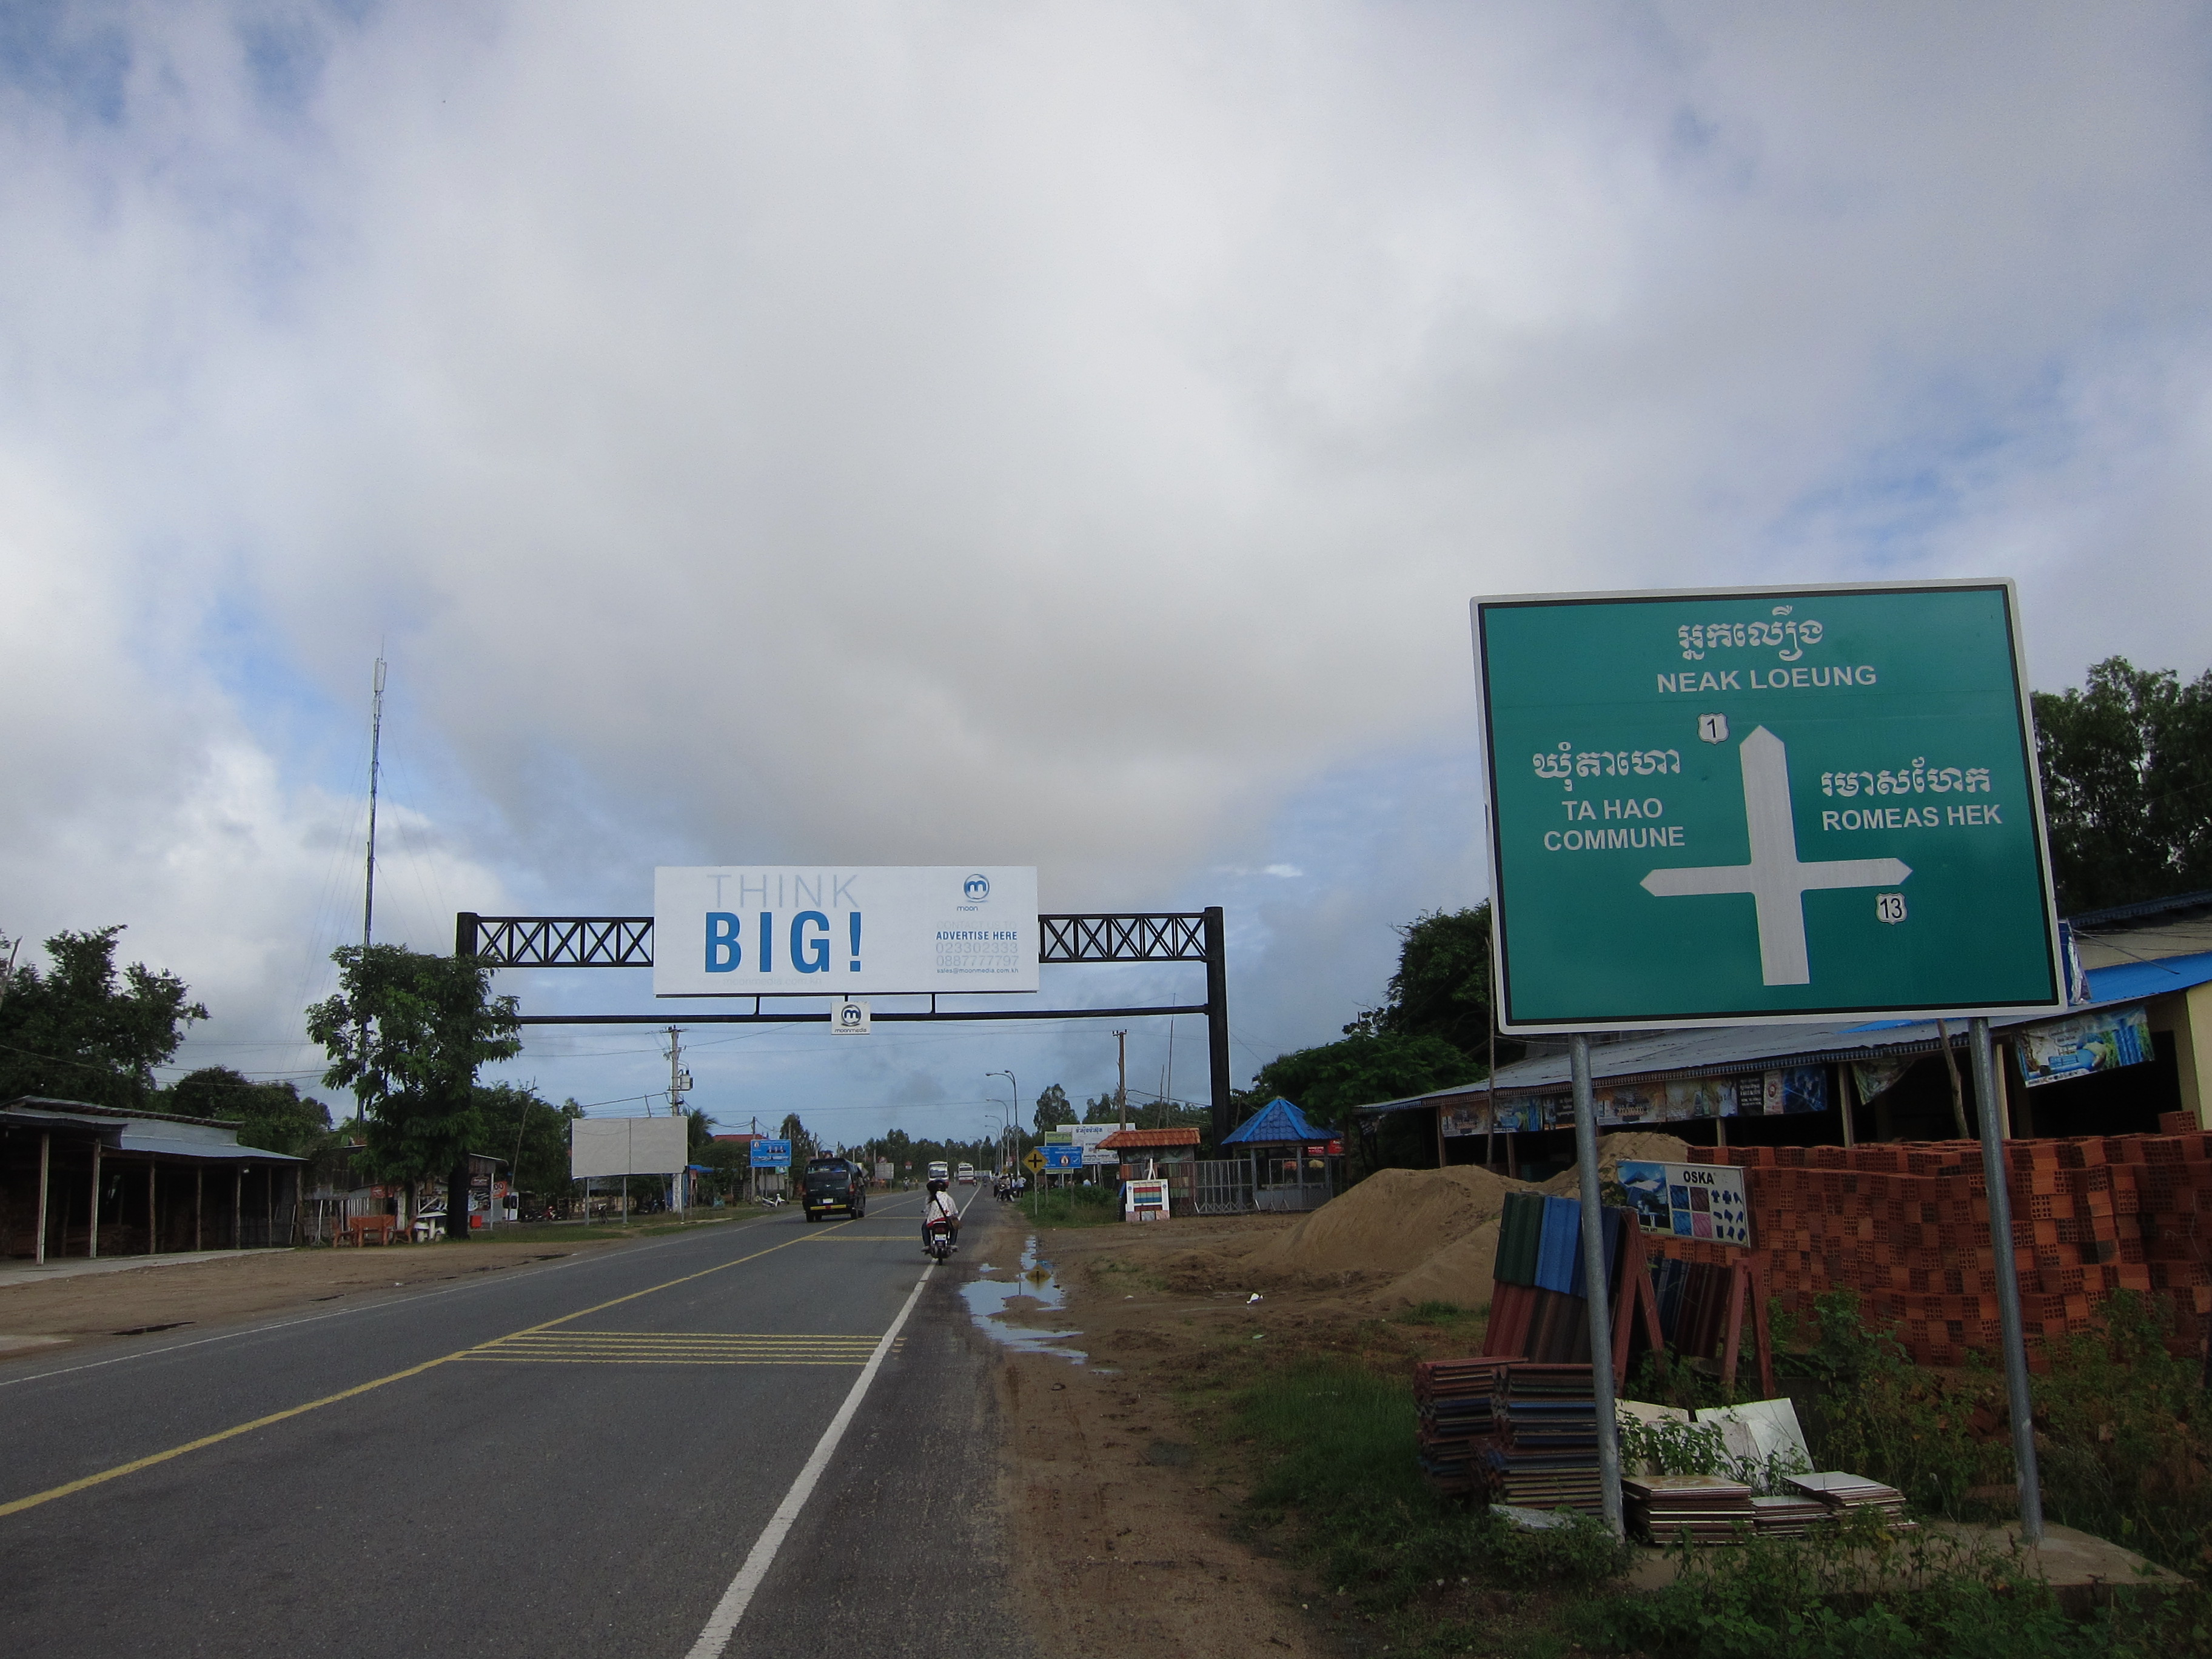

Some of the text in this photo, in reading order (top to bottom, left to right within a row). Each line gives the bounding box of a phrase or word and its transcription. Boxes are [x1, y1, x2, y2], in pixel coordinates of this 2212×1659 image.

[1657, 665, 1877, 693] NEAK LOEUNG
[1707, 719, 1717, 738] 1
[1561, 797, 1663, 821] TA HAO
[1822, 804, 2003, 831] ROMEAS HEK
[1544, 826, 1685, 851] COMMUNE
[706, 874, 859, 908] THINK
[1880, 898, 1903, 919] 13
[936, 920, 1017, 930] CONTACT US TO
[936, 931, 1017, 940] ADVERTISE HERE
[705, 911, 861, 974] BIG!
[936, 942, 1019, 954] 023302333
[936, 955, 1019, 967] 0887777797
[1683, 1170, 1715, 1185] OSKA
